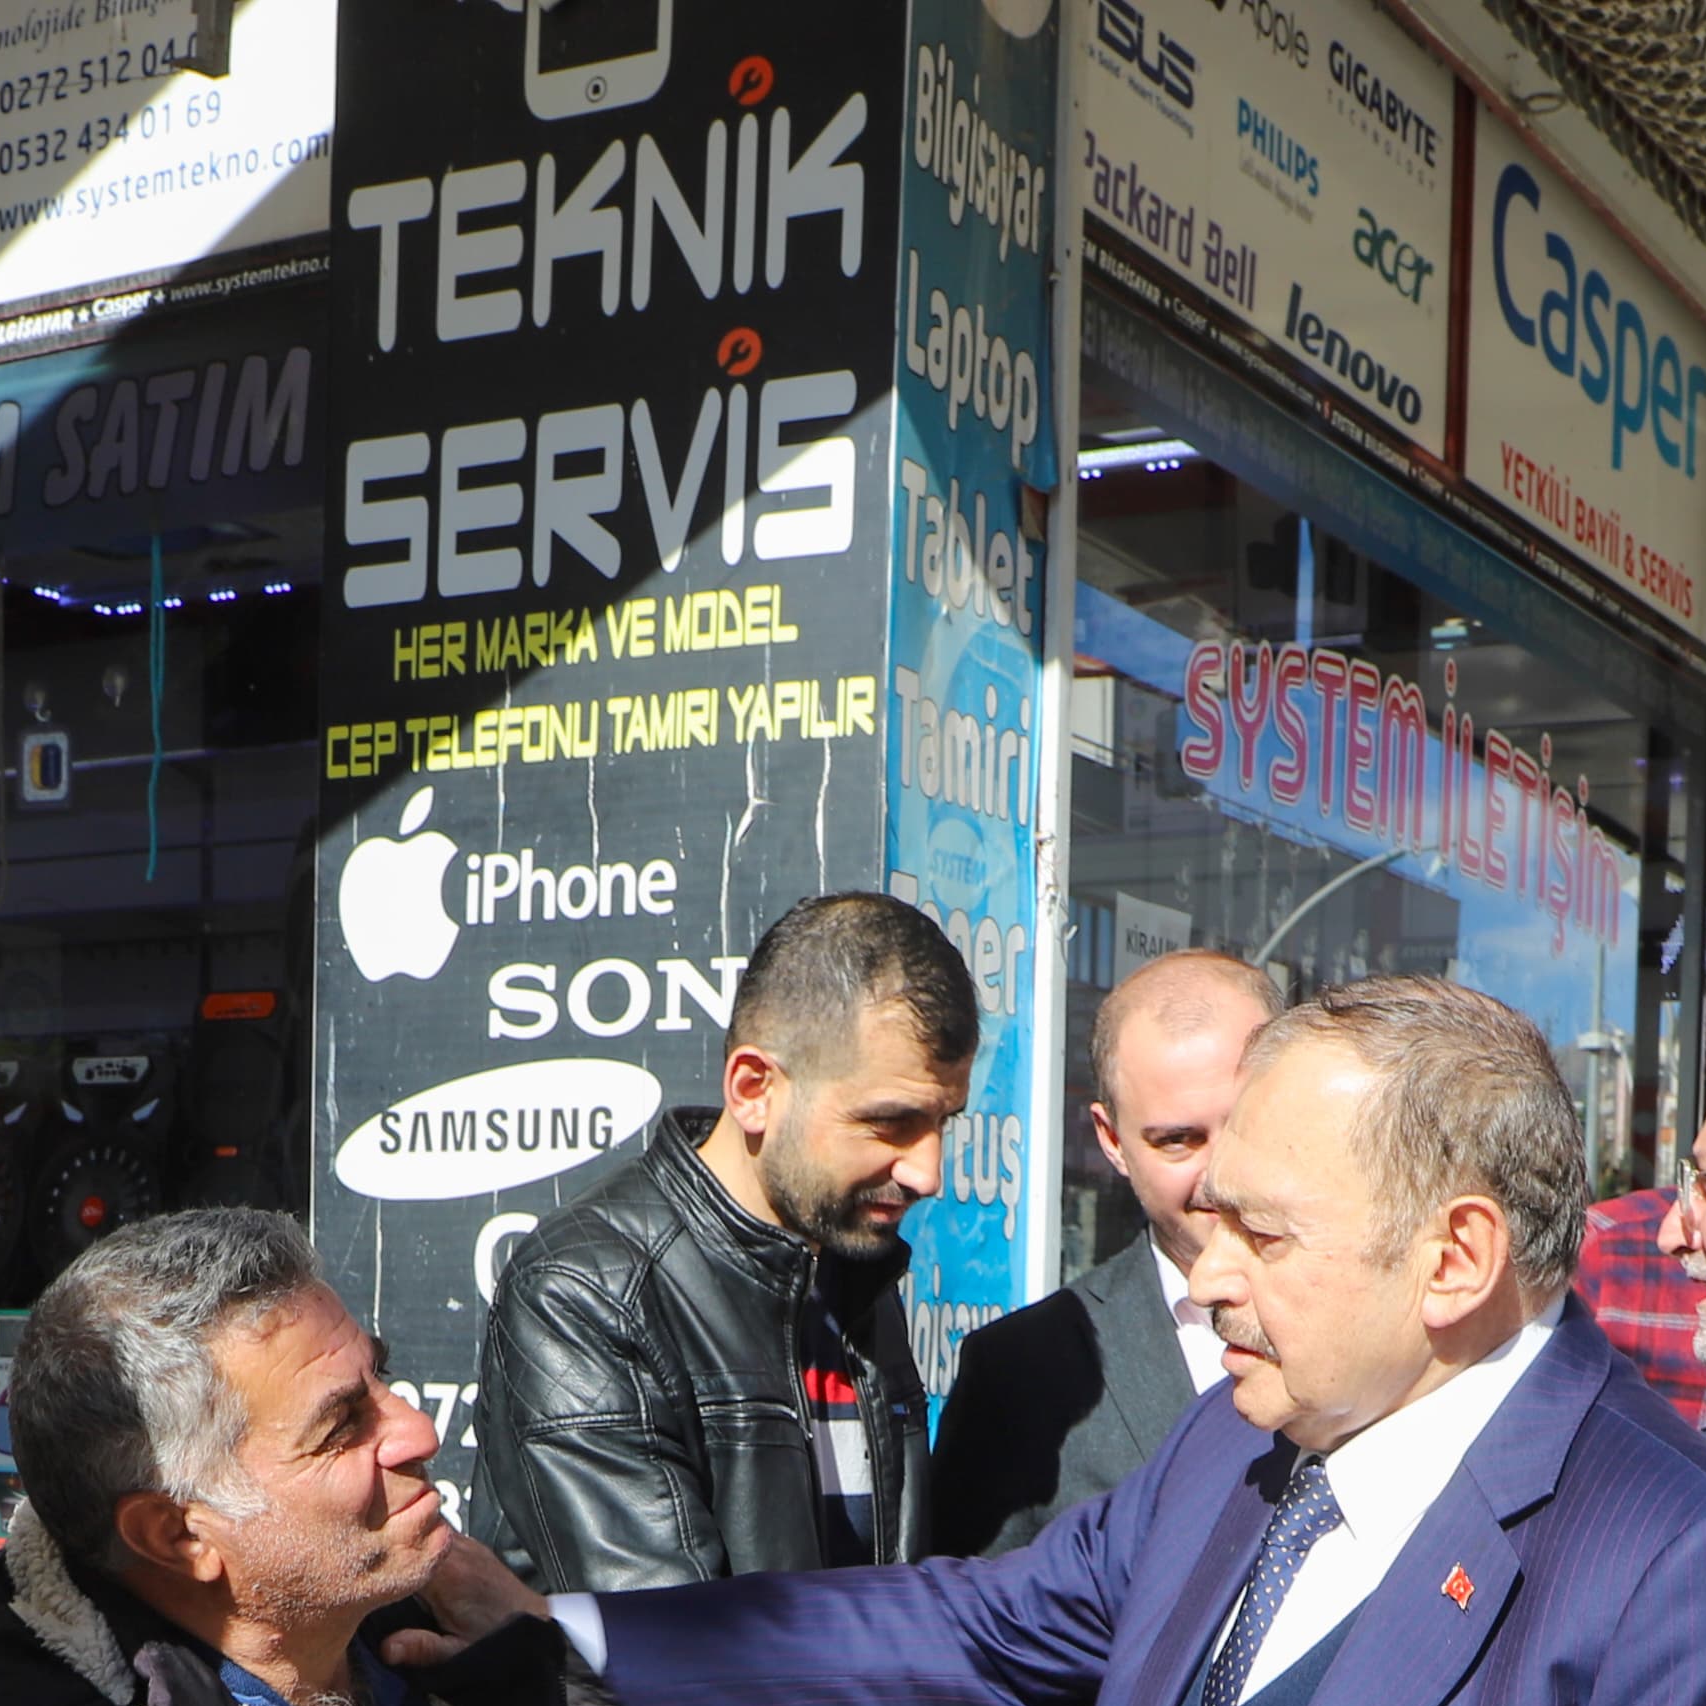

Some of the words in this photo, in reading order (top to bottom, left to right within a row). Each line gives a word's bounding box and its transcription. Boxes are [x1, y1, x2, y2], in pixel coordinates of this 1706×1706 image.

[0, 67, 70, 114] 0272
[79, 49, 131, 93] 512
[1097, 0, 1196, 110] SUS
[1328, 40, 1437, 168] GIGABYTE
[76, 112, 130, 153] 434
[139, 100, 173, 140] 01
[185, 89, 224, 128] 69
[913, 43, 1045, 263] Bilgisayar
[1236, 96, 1322, 198] PHILIPS
[347, 56, 868, 353] TEKNİK
[1351, 207, 1435, 306] acer
[91, 288, 152, 321] Casper
[169, 253, 331, 303] www.systemtekno.c
[1202, 218, 1258, 313] Bell
[906, 248, 1039, 471] Laptop
[1284, 281, 1422, 426] lenovo
[43, 345, 312, 509] SATIM
[343, 327, 858, 609] SERVİS
[901, 458, 1034, 638] Tablet
[1500, 440, 1572, 533] YETKİLİ
[1623, 534, 1636, 579] &
[1639, 546, 1694, 620] SERVİS
[394, 620, 466, 682] HER
[476, 606, 598, 673] MARKA
[606, 597, 656, 659] VE
[664, 583, 799, 654] MODEL
[326, 721, 398, 780] CEP
[405, 700, 600, 773] TELEFONU
[606, 687, 718, 755] TAMIRI
[726, 675, 876, 746] YAPILIR
[895, 665, 1031, 828] Tamiri
[1181, 637, 1429, 855] SYSTEM
[465, 848, 677, 925] iPhone
[488, 957, 750, 1040] SON
[379, 1105, 614, 1155] SAMSUNG
